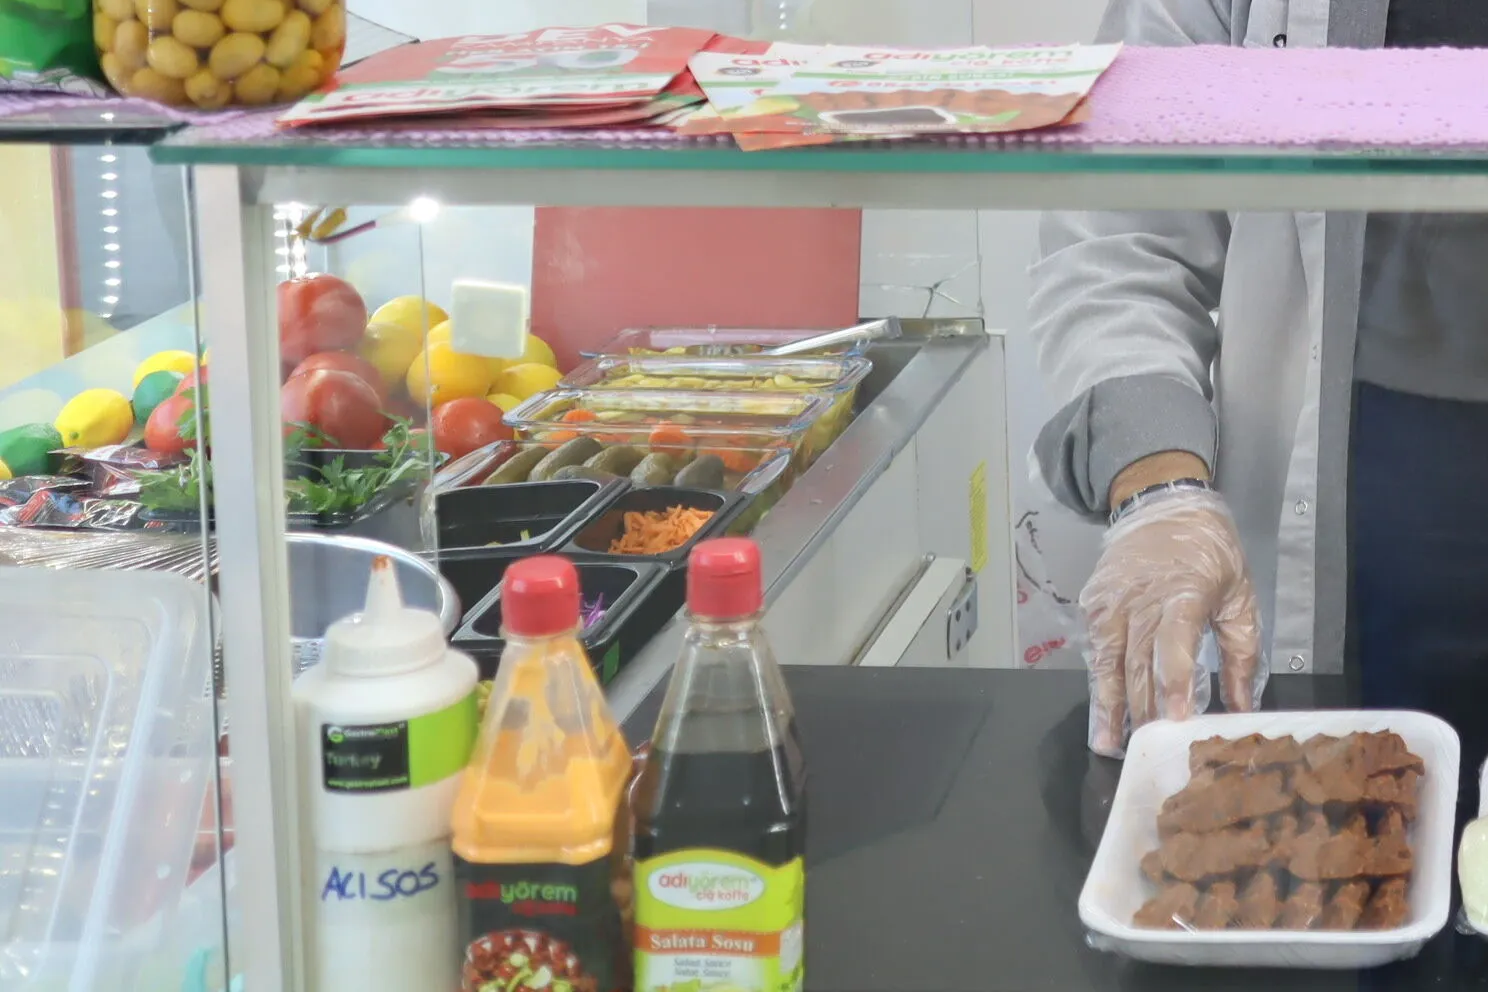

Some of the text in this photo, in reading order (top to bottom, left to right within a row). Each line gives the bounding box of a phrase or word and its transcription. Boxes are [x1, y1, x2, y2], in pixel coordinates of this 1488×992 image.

[370, 862, 440, 901] SOS
[650, 934, 755, 952] Salata Sosu
